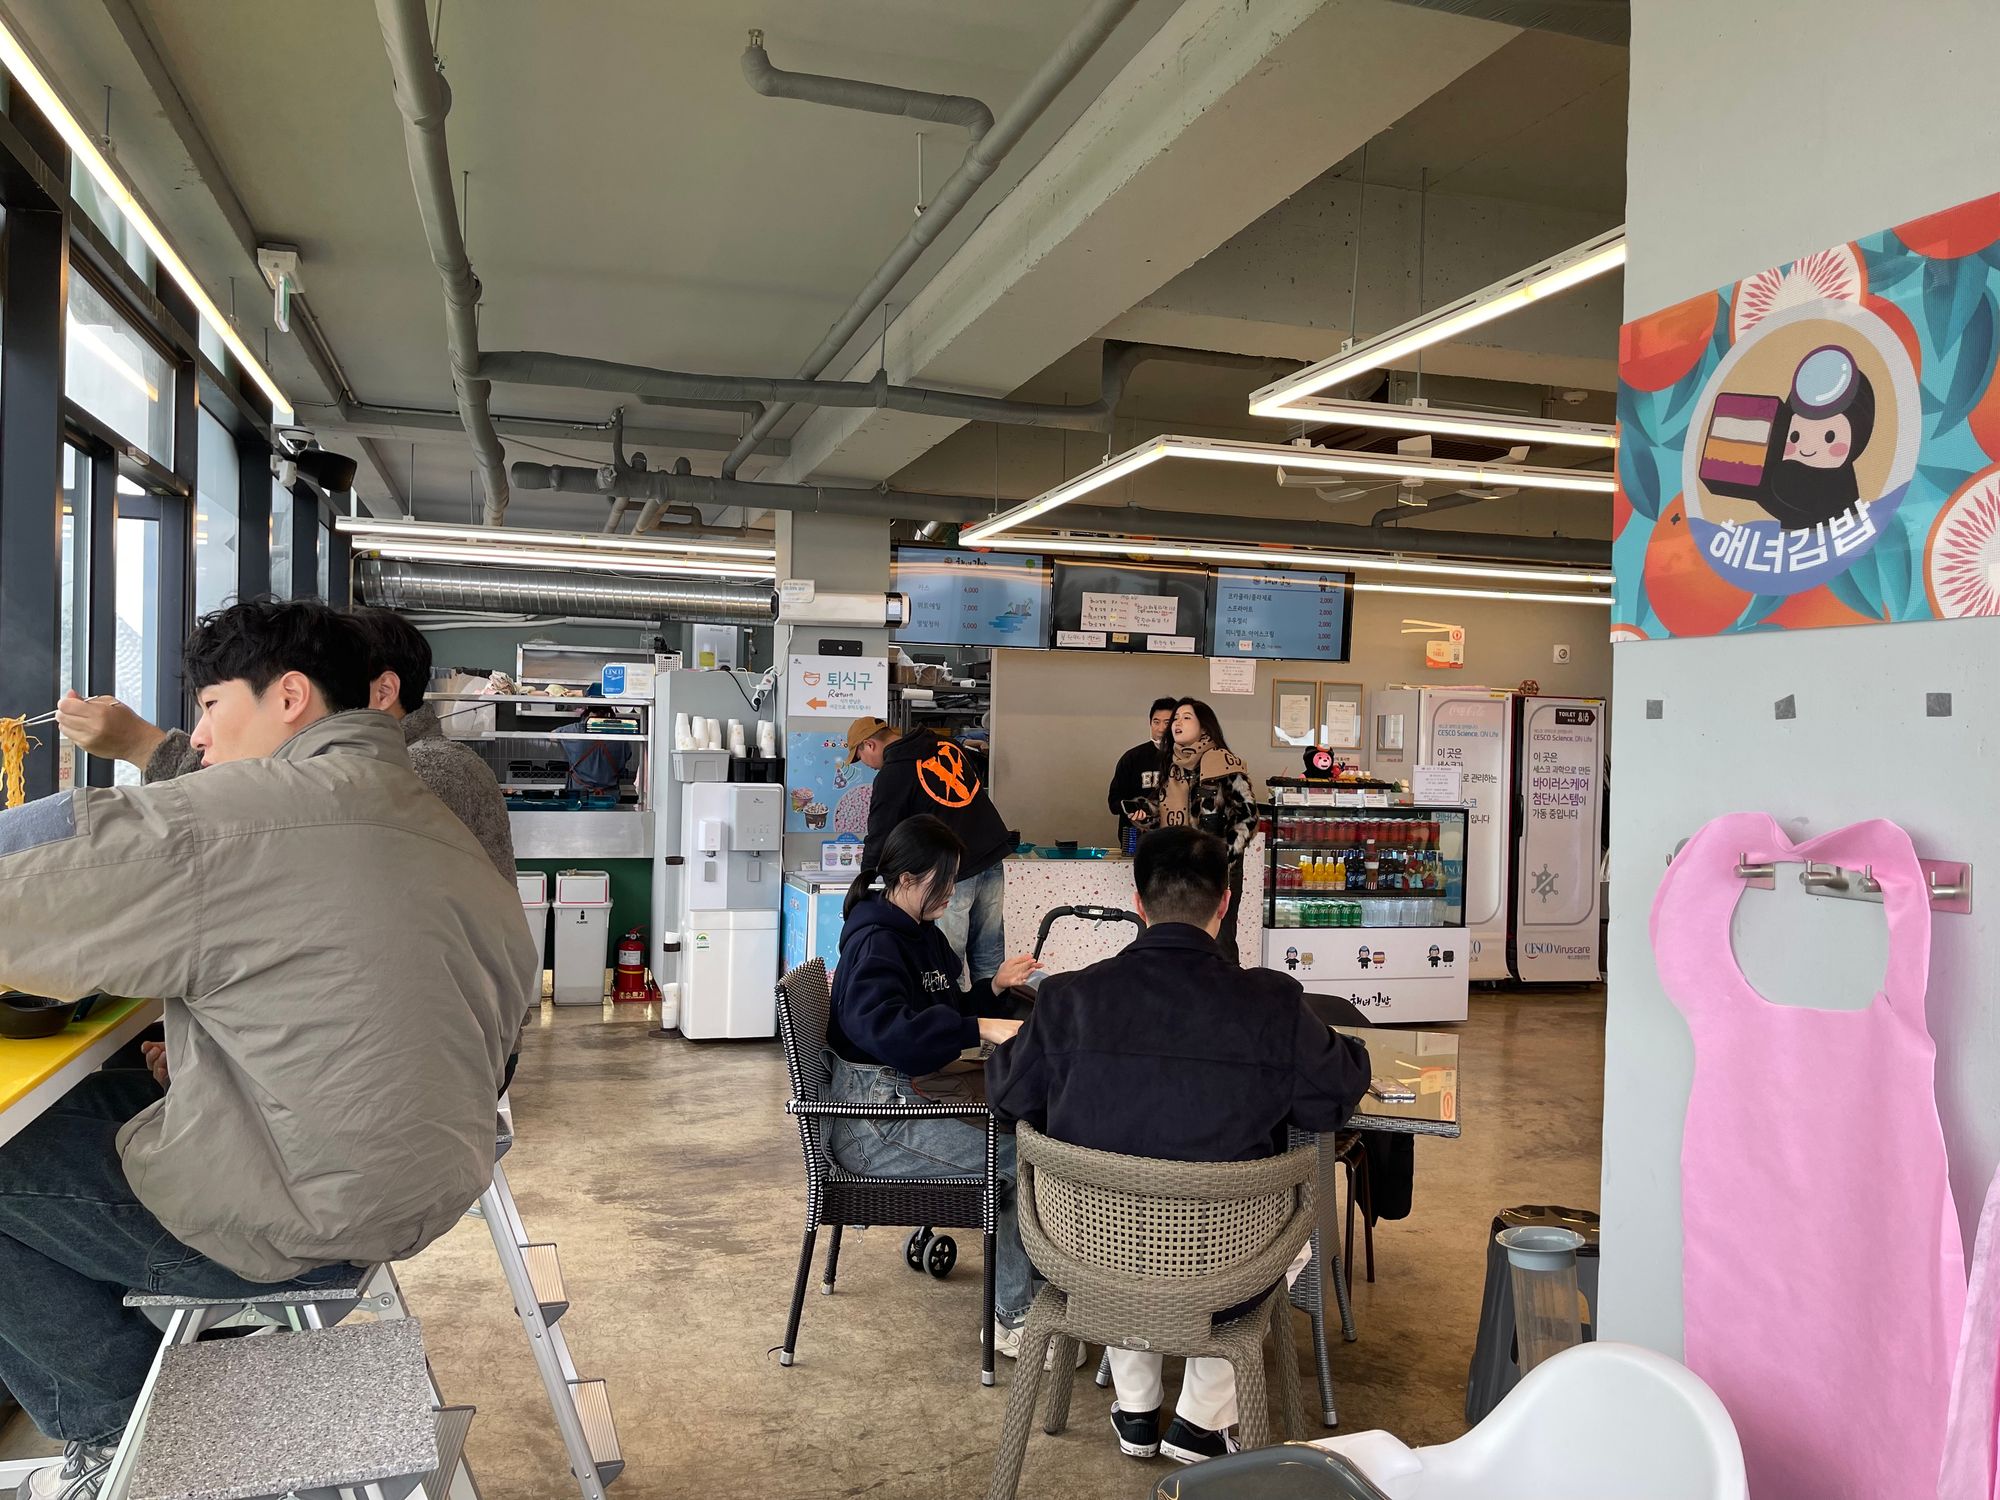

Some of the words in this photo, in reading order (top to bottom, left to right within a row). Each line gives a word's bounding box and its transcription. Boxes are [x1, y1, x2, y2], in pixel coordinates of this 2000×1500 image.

[1709, 498, 1877, 574] 해녀김밥
[1248, 630, 1275, 638] 아이스크림
[827, 671, 872, 691] 퇴식구
[828, 689, 853, 698] Return
[1437, 748, 1445, 758] 이
[1446, 748, 1462, 758] 곳은
[1533, 752, 1541, 762] 이
[1542, 752, 1558, 763] 곳은
[1533, 766, 1550, 774] 세스코
[1552, 766, 1576, 774] 과학으로
[1578, 767, 1590, 775] 만든
[1471, 774, 1497, 783] 관리하는
[1533, 777, 1589, 791] 바이러스케어
[1461, 799, 1477, 808] 스코
[1533, 793, 1586, 806] 첨단시스템이
[1533, 809, 1547, 819] 가동
[1549, 809, 1578, 819] 중입니다
[1524, 943, 1553, 954] CESCO
[1553, 944, 1590, 954] Viruscare
[1350, 992, 1391, 1006] 해녀김밥
